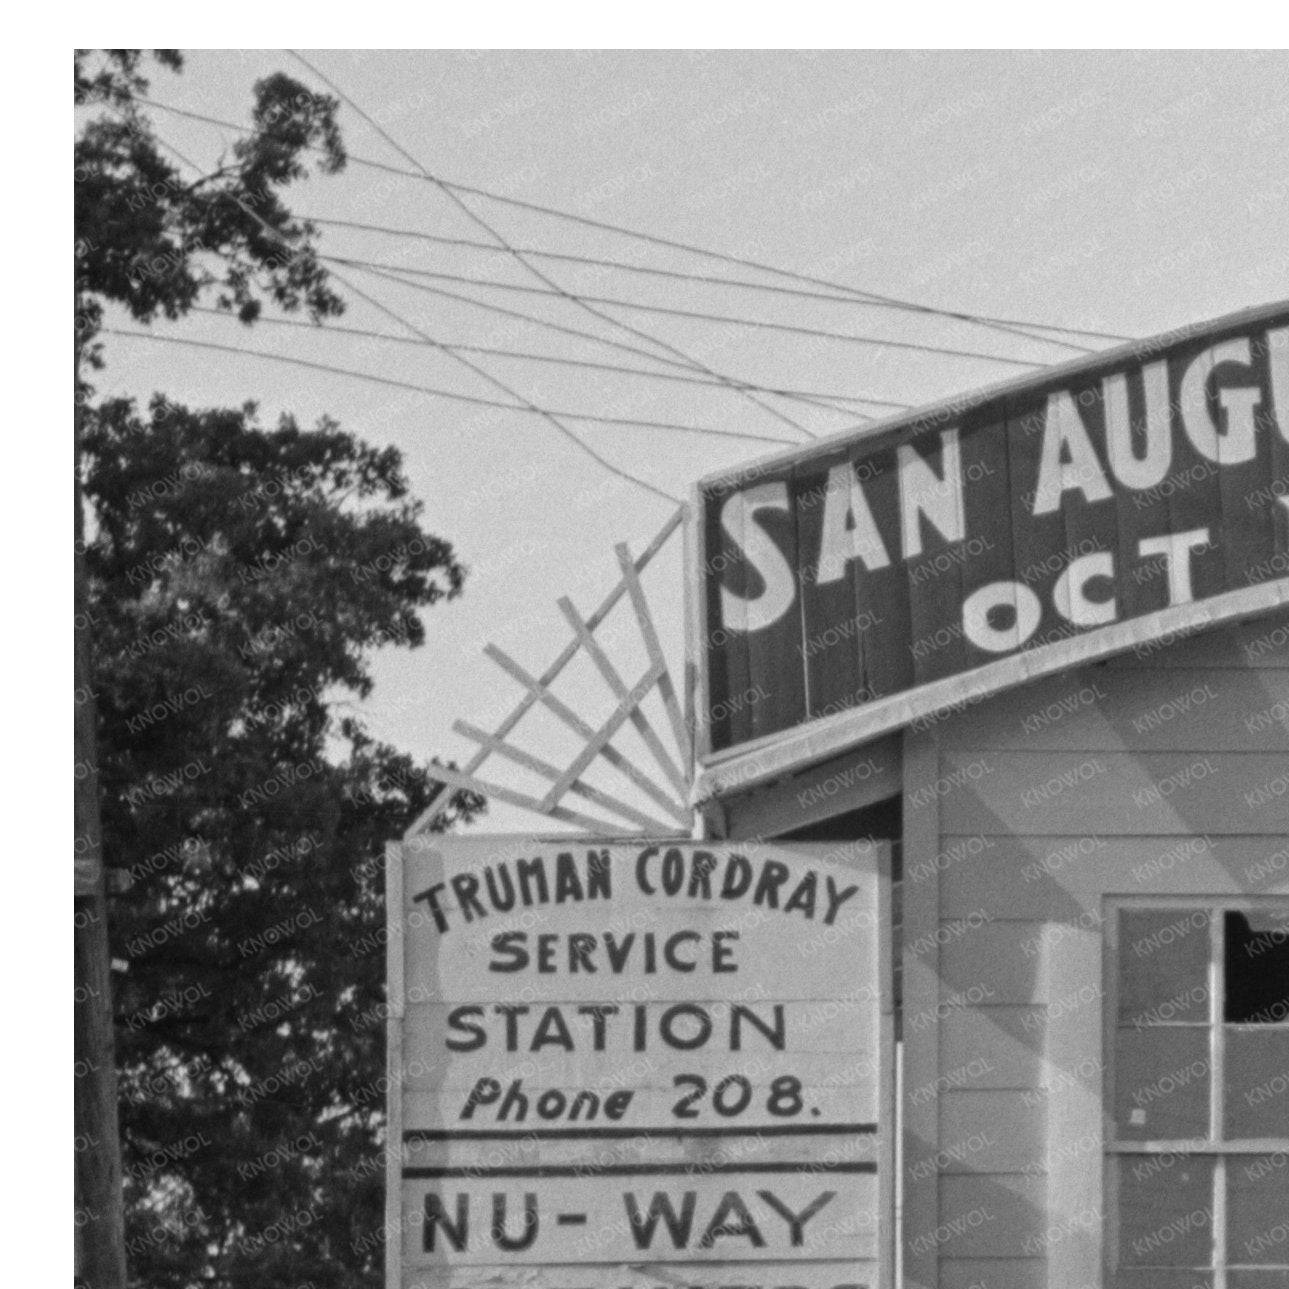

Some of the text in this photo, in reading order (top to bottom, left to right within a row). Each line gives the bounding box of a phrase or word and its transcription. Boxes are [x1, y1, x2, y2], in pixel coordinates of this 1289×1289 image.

[719, 428, 966, 632] SAN
[963, 528, 1211, 652] OCT
[413, 845, 859, 934] TRUMAN CORDRAY
[489, 930, 739, 974] SERVICE
[445, 1003, 786, 1052] STATION
[460, 1074, 822, 1121] Phone 208.
